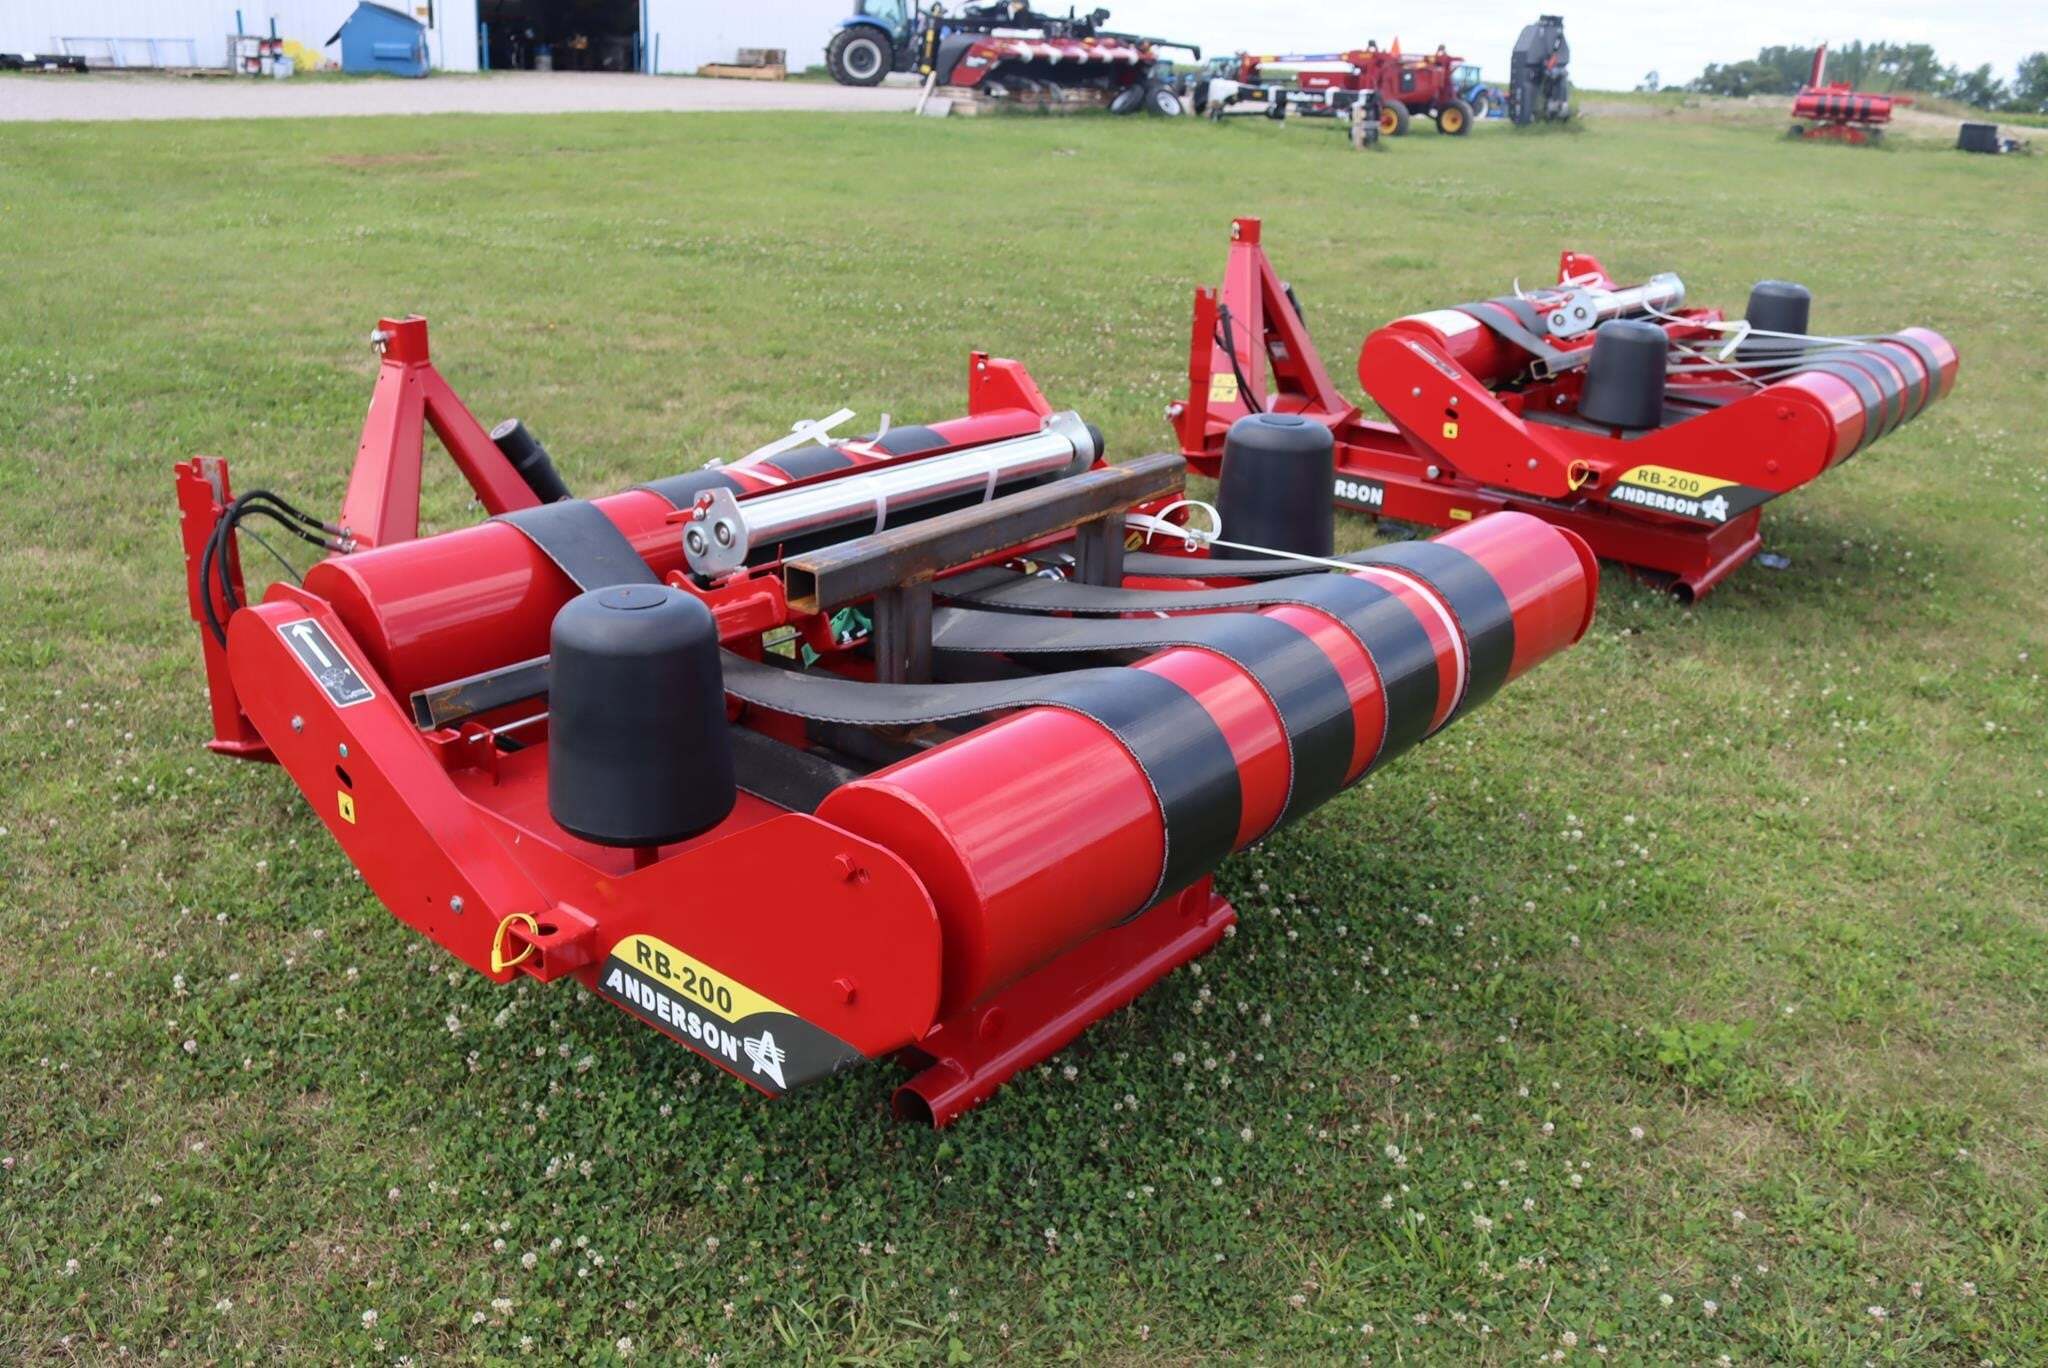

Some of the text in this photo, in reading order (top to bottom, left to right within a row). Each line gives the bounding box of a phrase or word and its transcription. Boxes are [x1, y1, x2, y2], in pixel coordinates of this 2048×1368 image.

[1611, 485, 1698, 515] ANDERSON
[1637, 469, 1699, 493] RB-200
[636, 939, 733, 1014] RB-200
[606, 967, 738, 1062] ANDERSON
